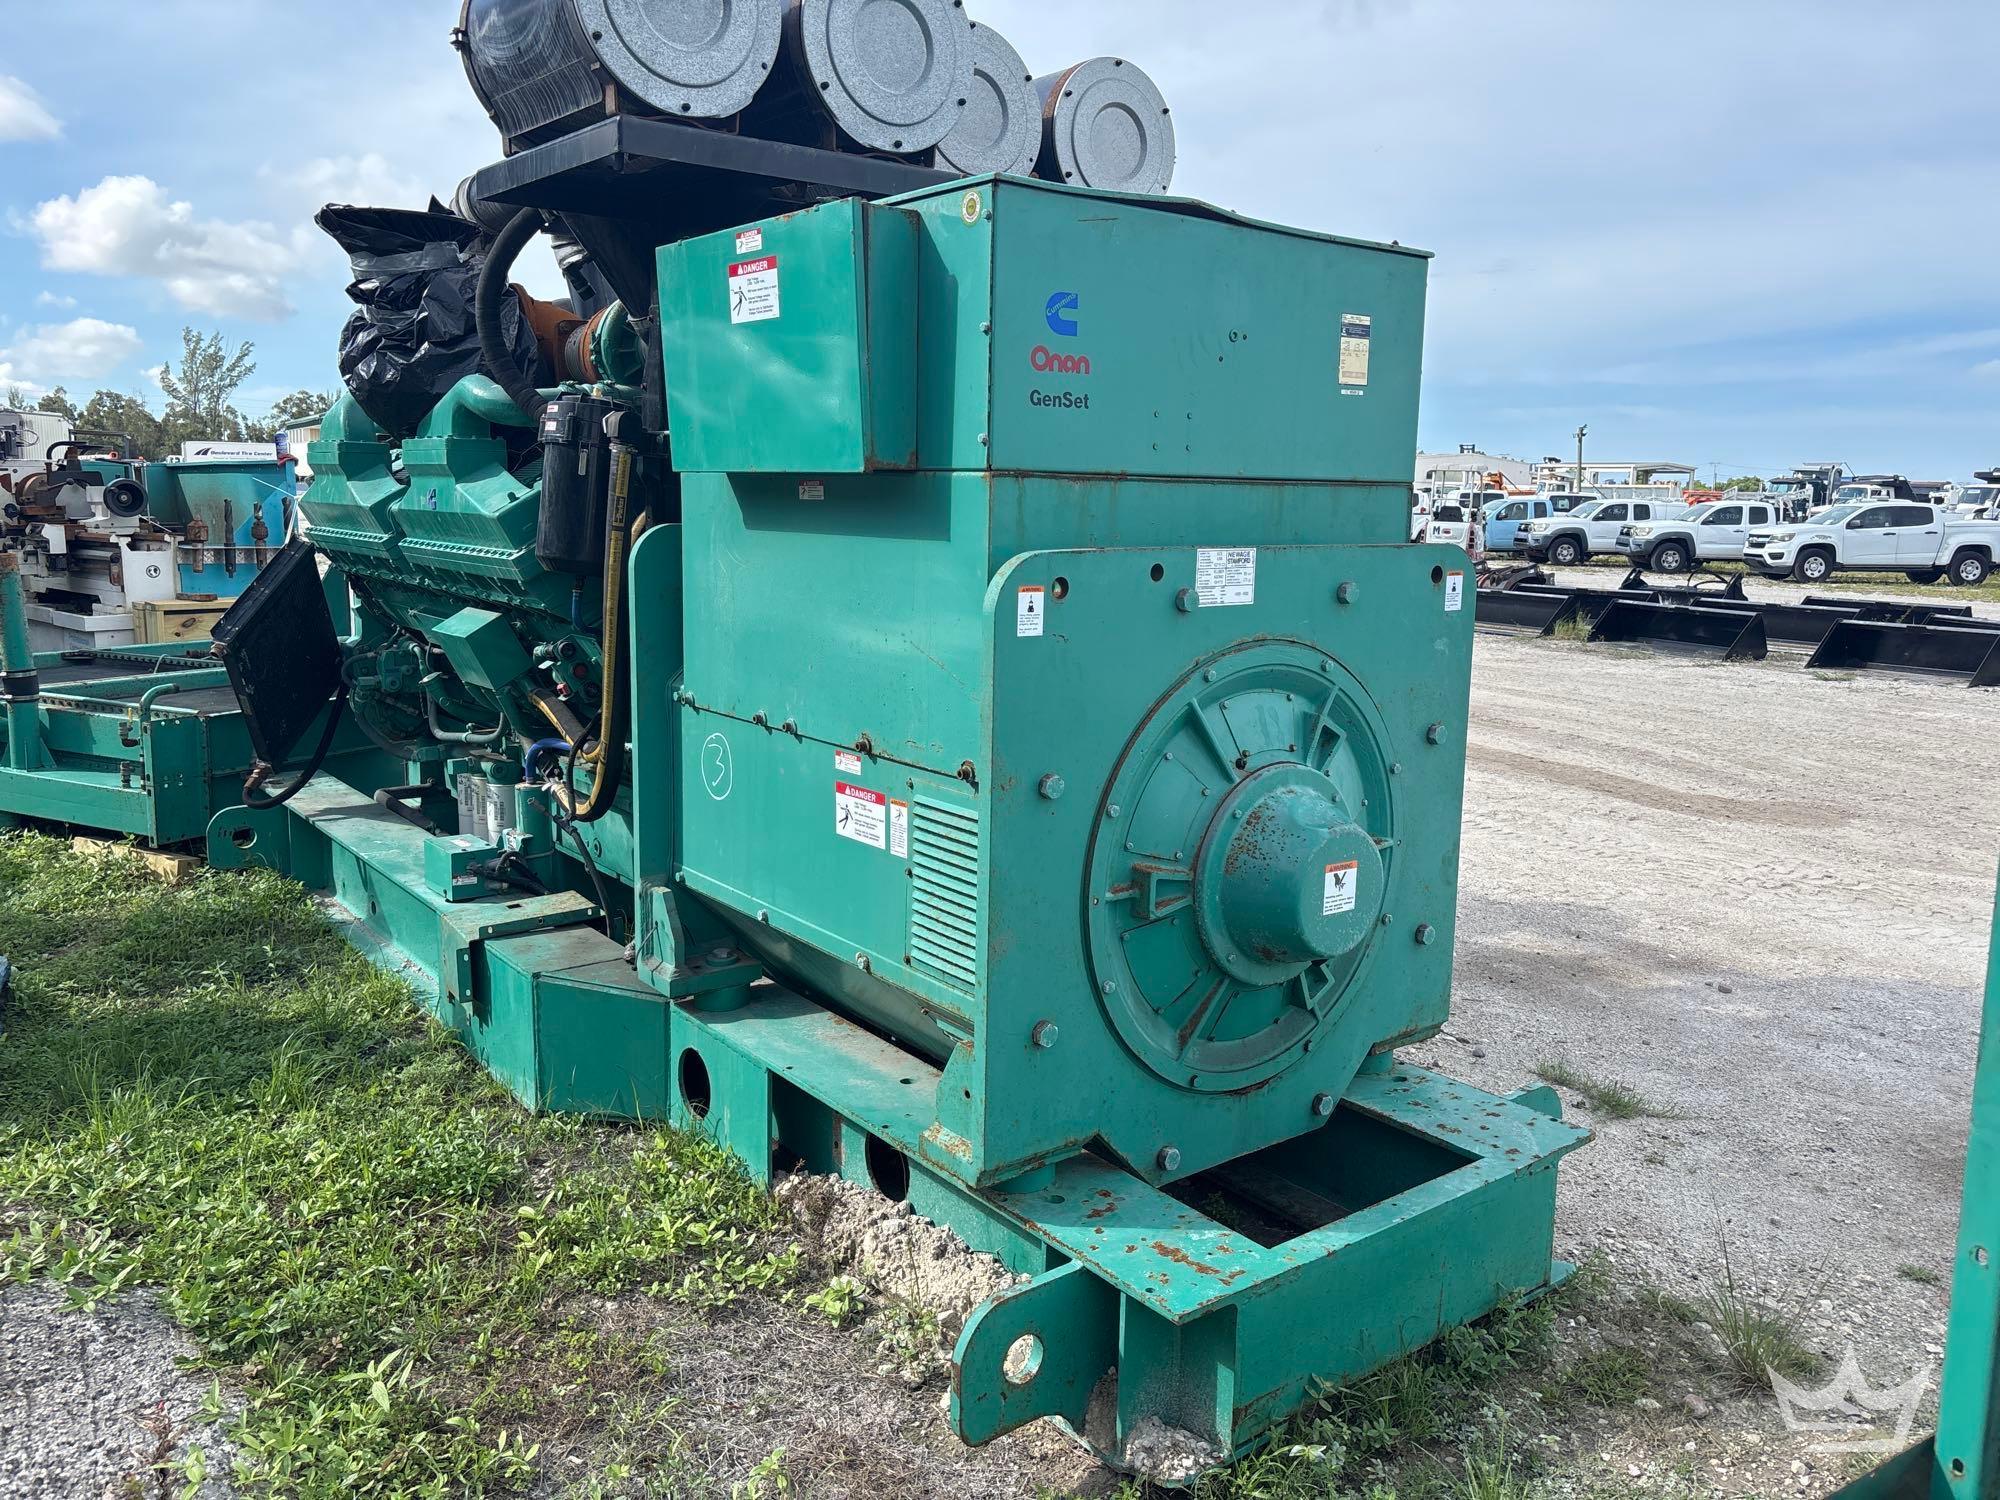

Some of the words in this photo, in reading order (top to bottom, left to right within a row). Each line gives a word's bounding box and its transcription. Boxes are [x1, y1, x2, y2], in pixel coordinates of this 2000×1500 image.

[744, 229, 757, 238] DANGER
[743, 260, 768, 273] DANGER
[1046, 293, 1076, 316] Cummins
[1030, 345, 1090, 374] Onan
[1029, 389, 1089, 409] GenSet
[707, 743, 725, 787] 3
[850, 788, 876, 802] DANGER
